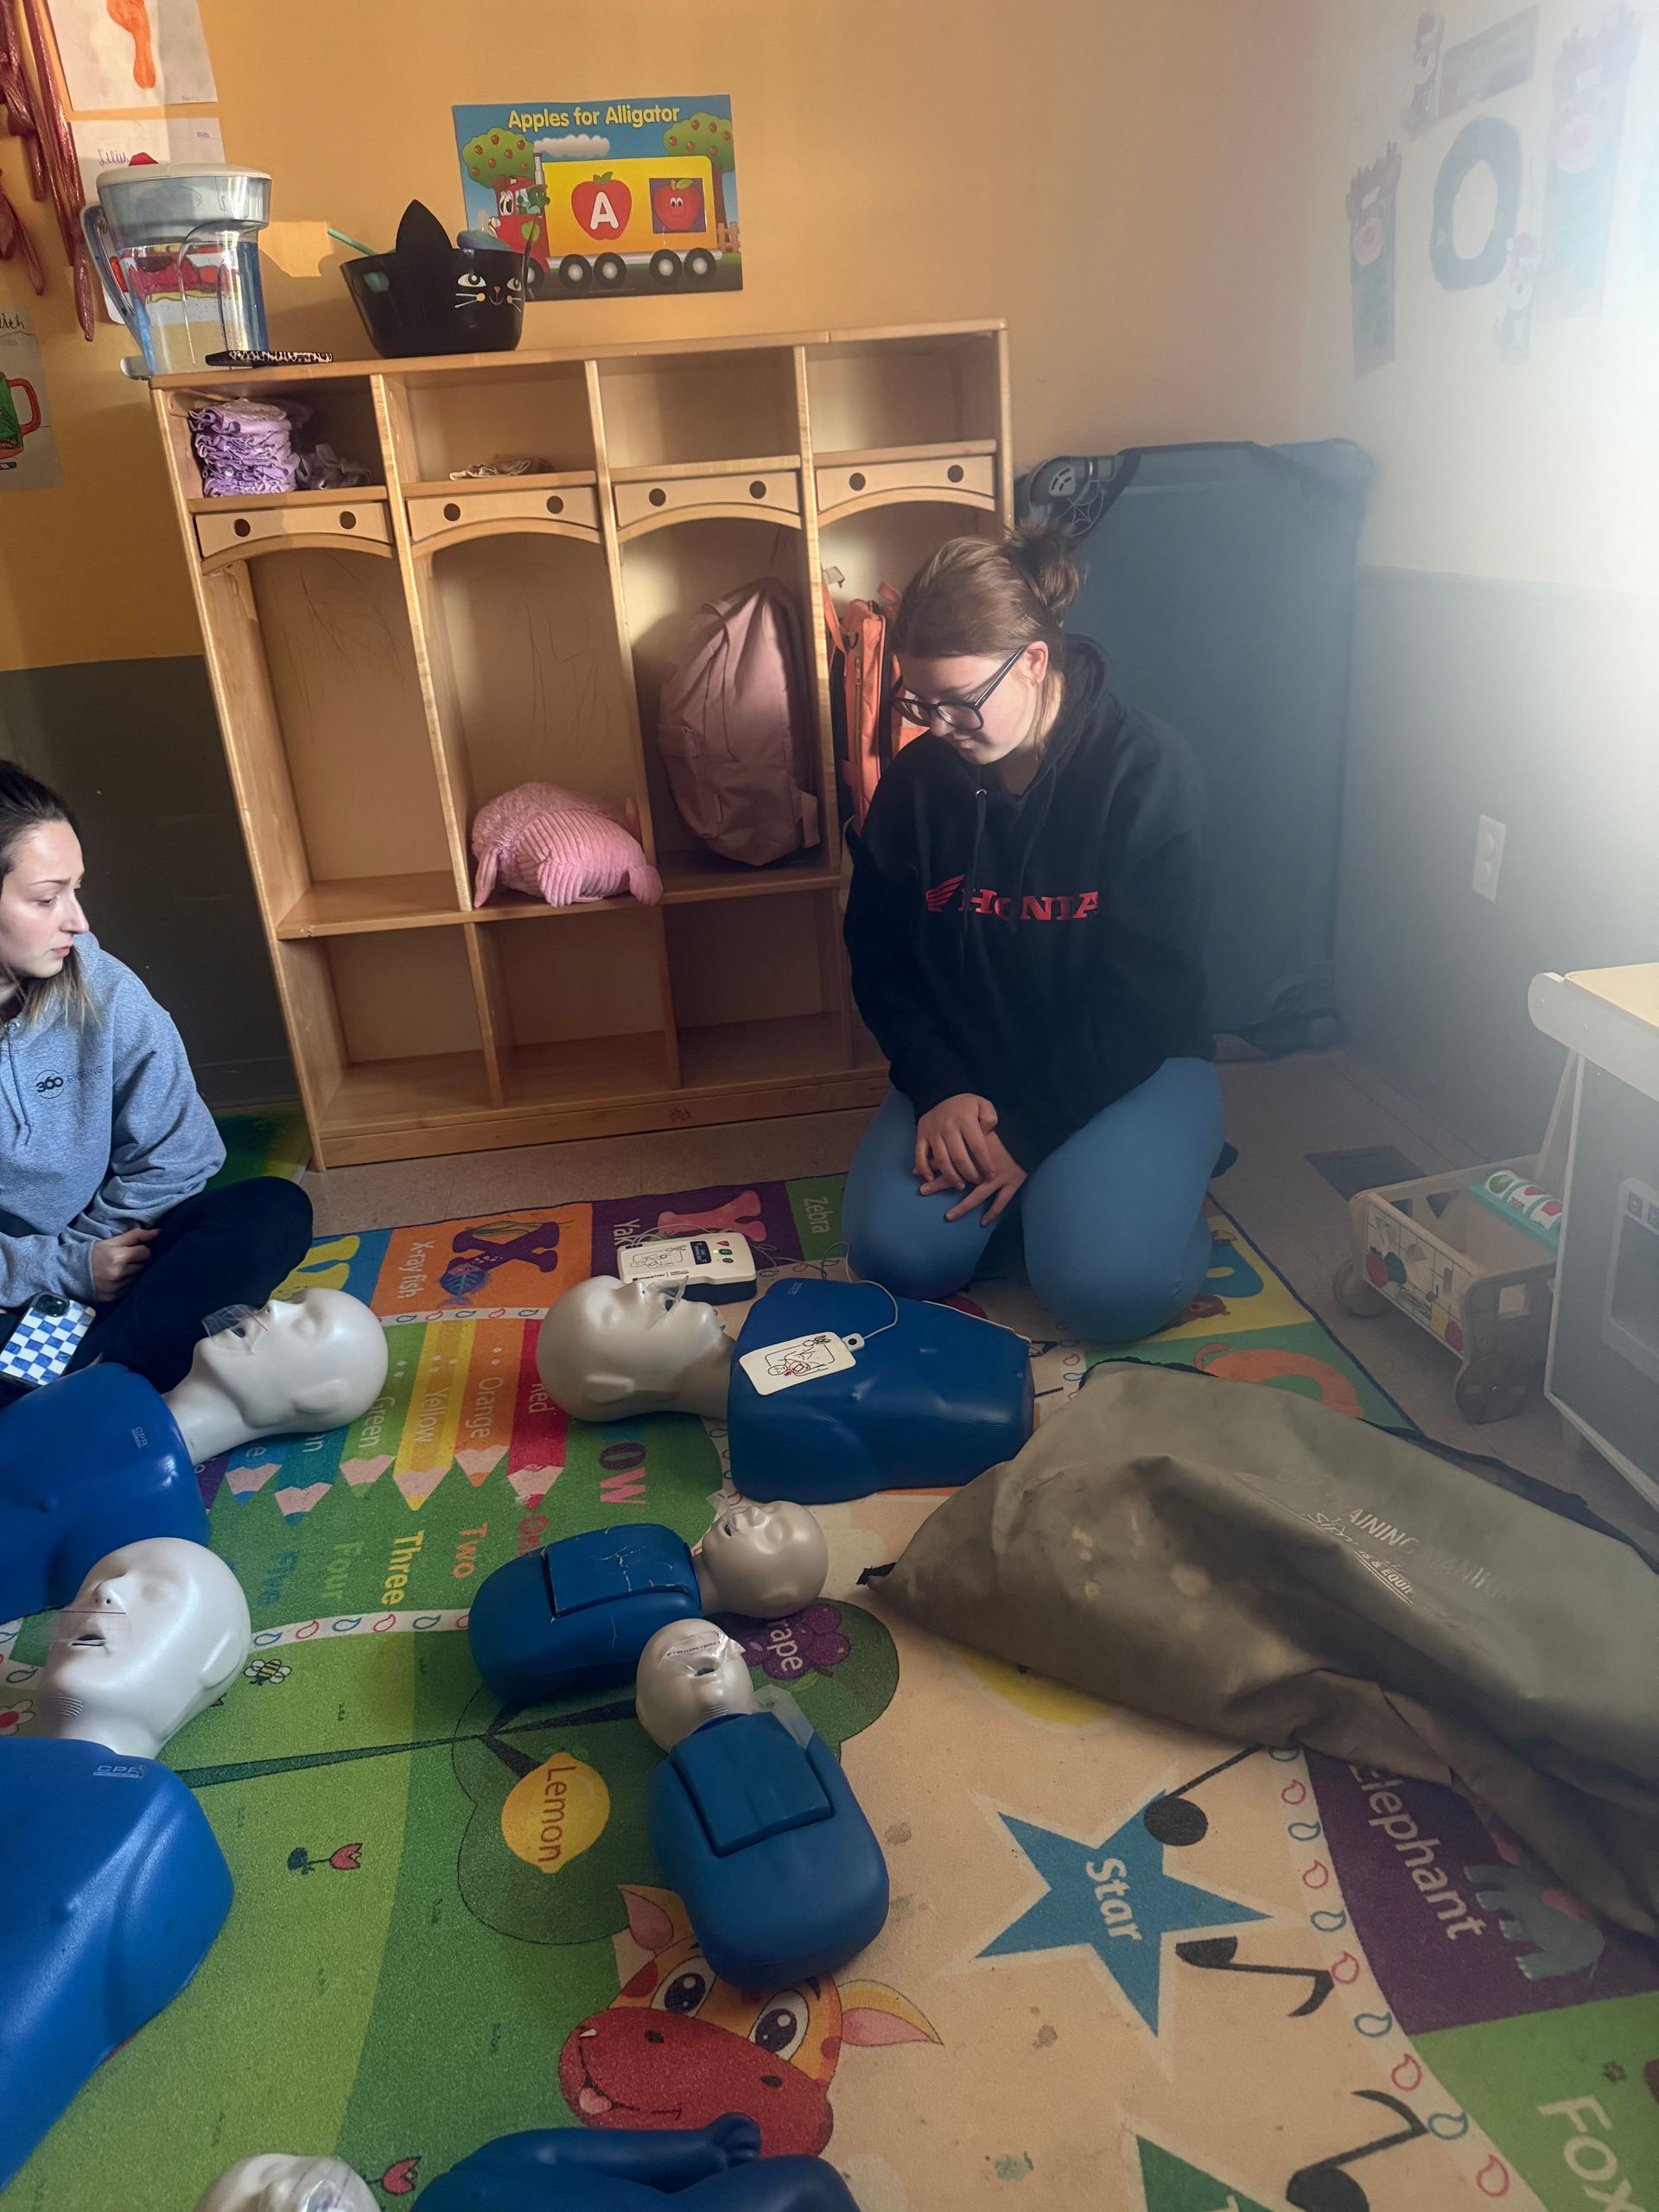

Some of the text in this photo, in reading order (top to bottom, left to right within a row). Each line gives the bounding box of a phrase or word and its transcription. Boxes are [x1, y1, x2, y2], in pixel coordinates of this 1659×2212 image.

[508, 105, 680, 132] Apples for Alligator
[589, 191, 620, 230] A
[35, 1077, 64, 1092] 360
[613, 1218, 641, 1245] Yak
[803, 1196, 835, 1234] Zebra
[397, 1240, 436, 1300] X-ray fish
[359, 1396, 396, 1448] Green
[415, 1388, 449, 1444] Yellow
[465, 1377, 505, 1439] Orange
[452, 1522, 488, 1580] Two
[517, 1515, 549, 1557] On
[317, 1541, 365, 1600] Four
[380, 1529, 425, 1605] Three
[766, 1620, 804, 1672] rape
[538, 1765, 577, 1862] Lemon
[1086, 1858, 1142, 1941] Star
